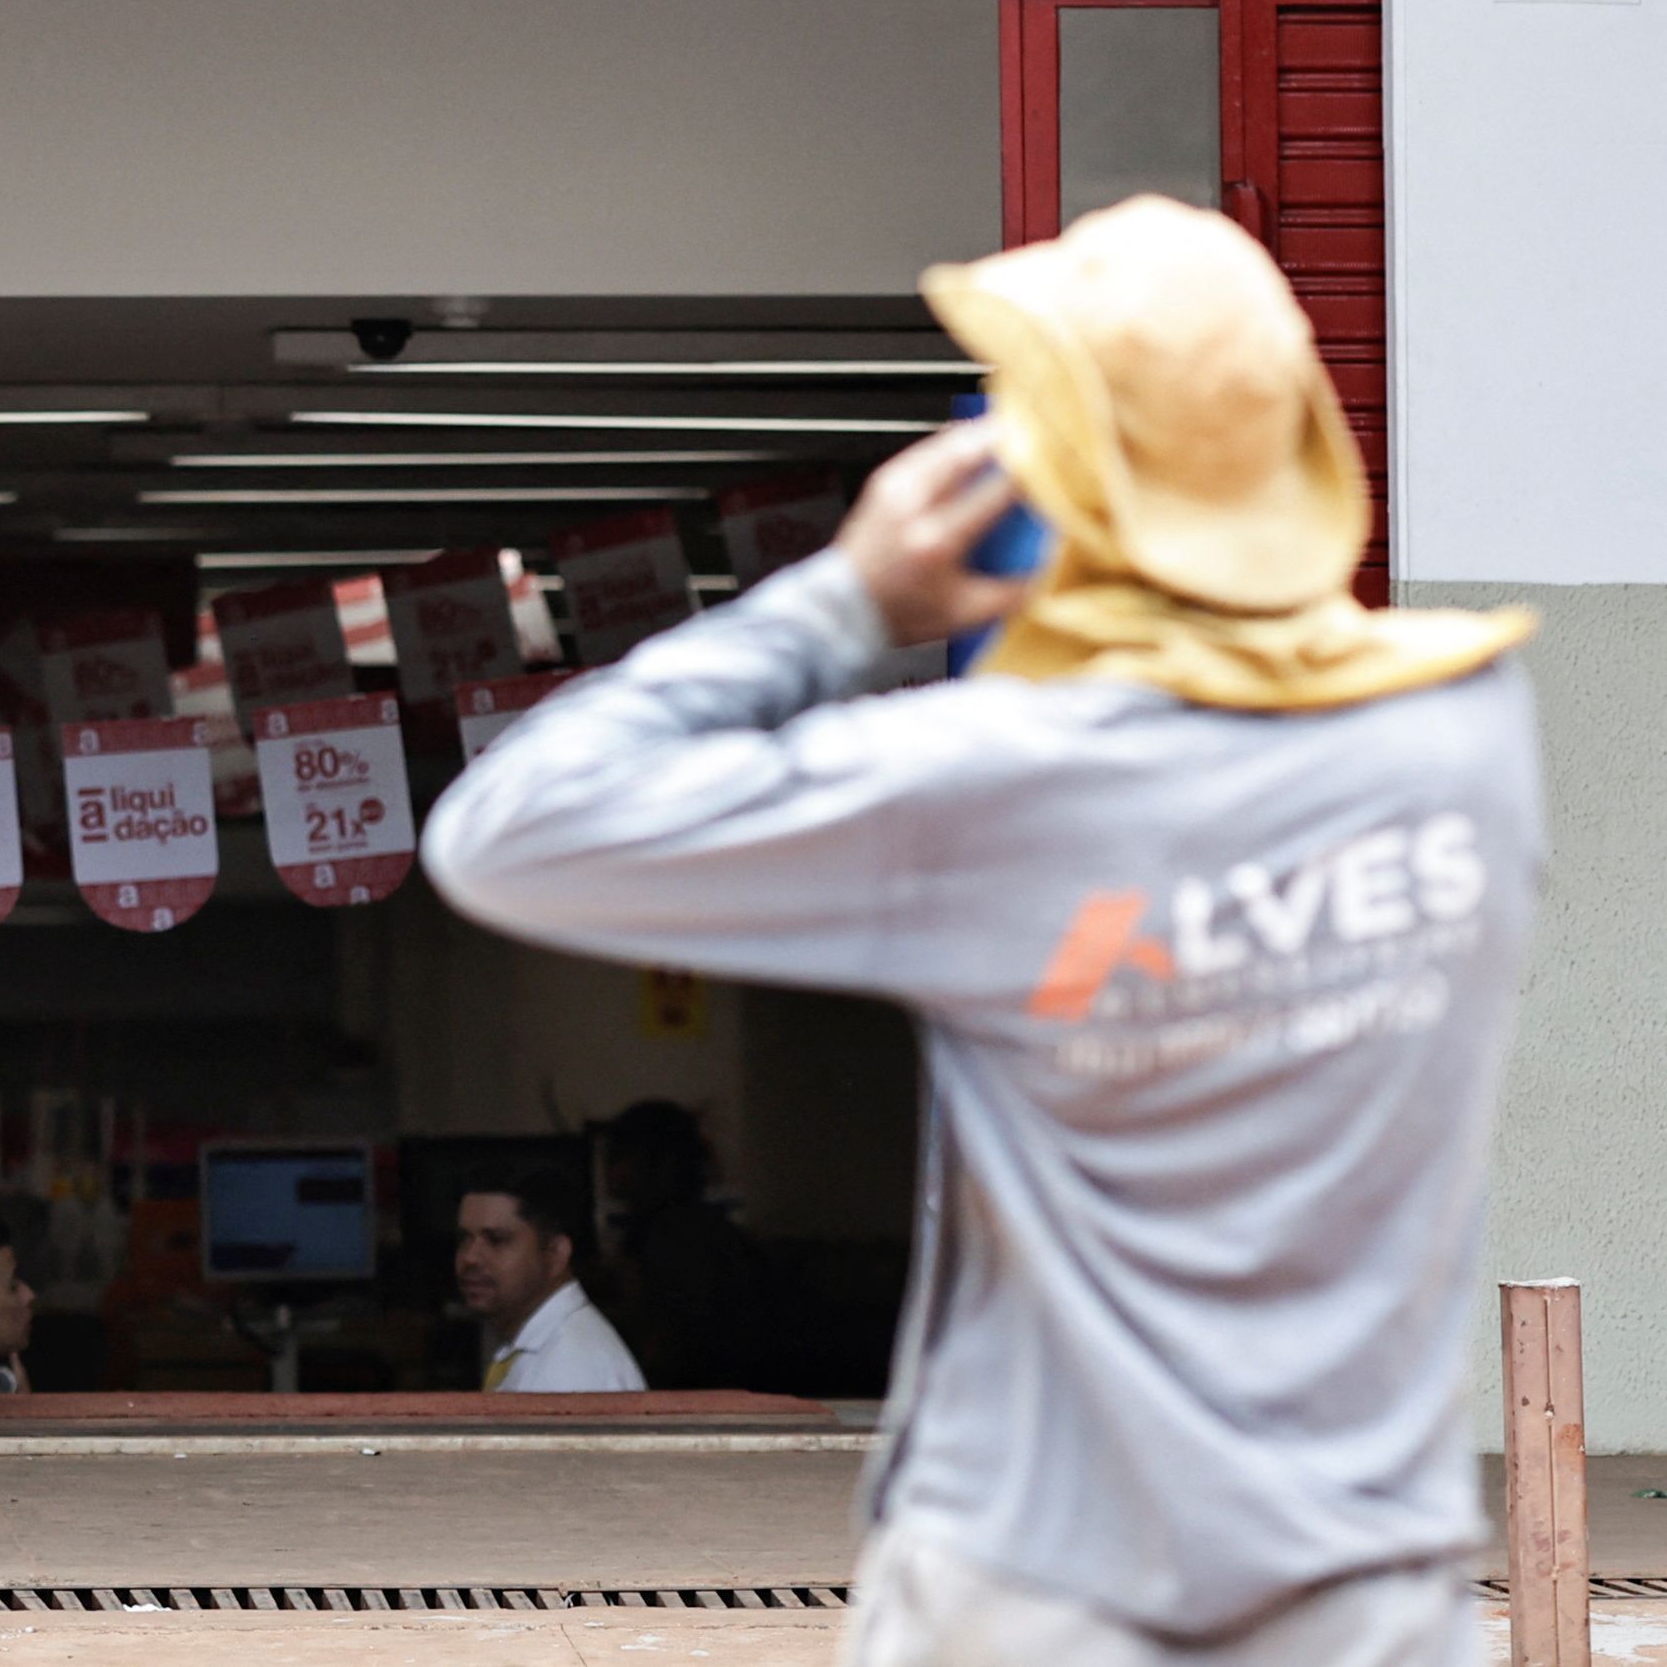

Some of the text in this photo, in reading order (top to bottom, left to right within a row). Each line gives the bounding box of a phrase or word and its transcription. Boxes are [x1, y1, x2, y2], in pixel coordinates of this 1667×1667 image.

[294, 746, 370, 782] 80%
[110, 782, 177, 817] liqui
[113, 810, 209, 847] dação
[305, 807, 368, 844] 21x
